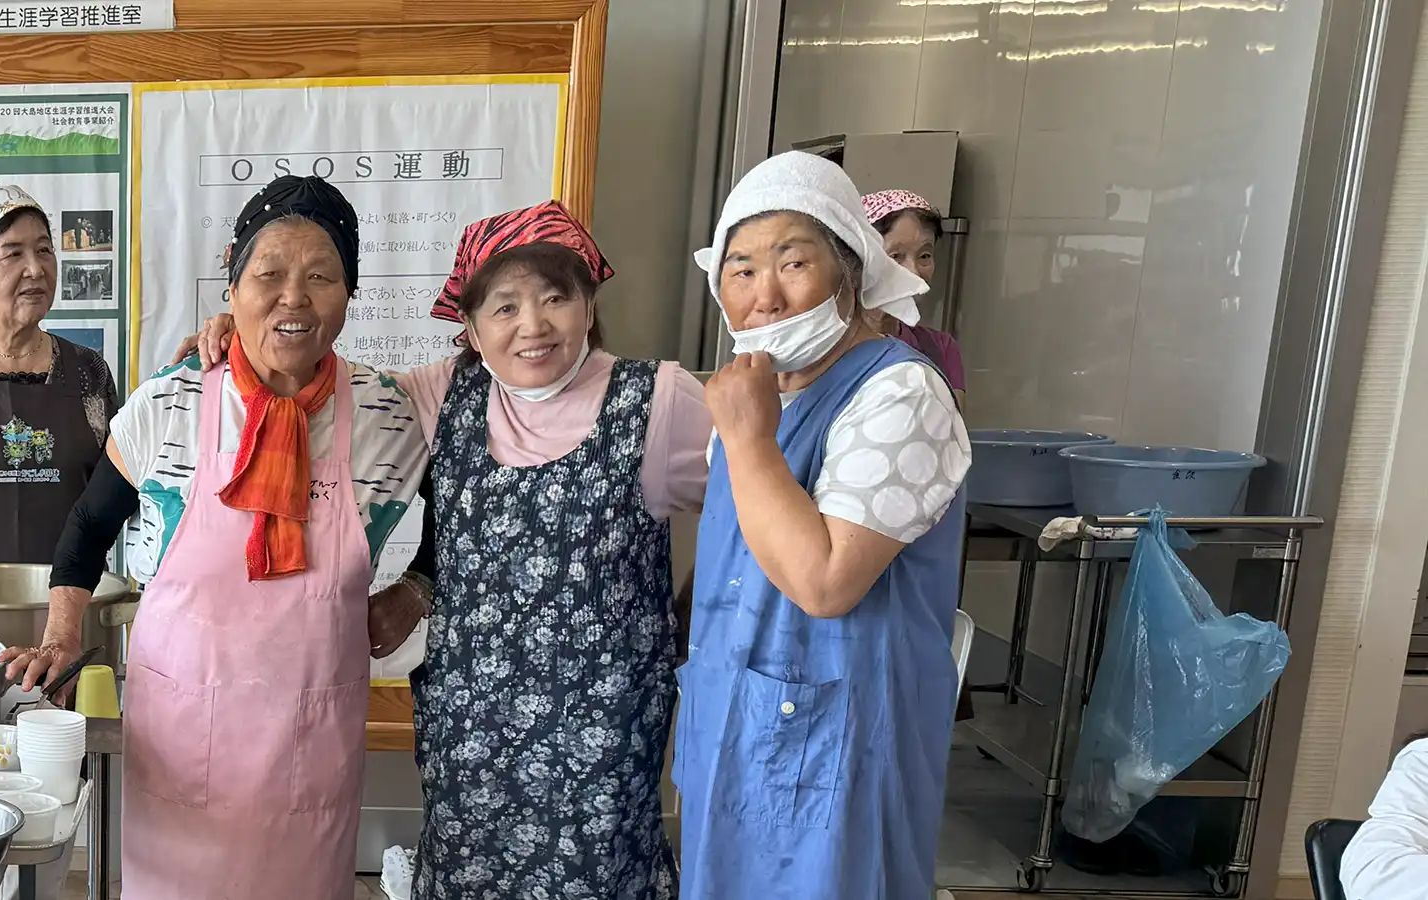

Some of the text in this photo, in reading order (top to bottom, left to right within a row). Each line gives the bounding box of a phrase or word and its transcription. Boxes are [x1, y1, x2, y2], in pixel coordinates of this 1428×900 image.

[52, 117, 114, 126] 社会教育事業紹介
[360, 240, 454, 253] 動に取り組んでい
[346, 306, 431, 321] 集落にしまし
